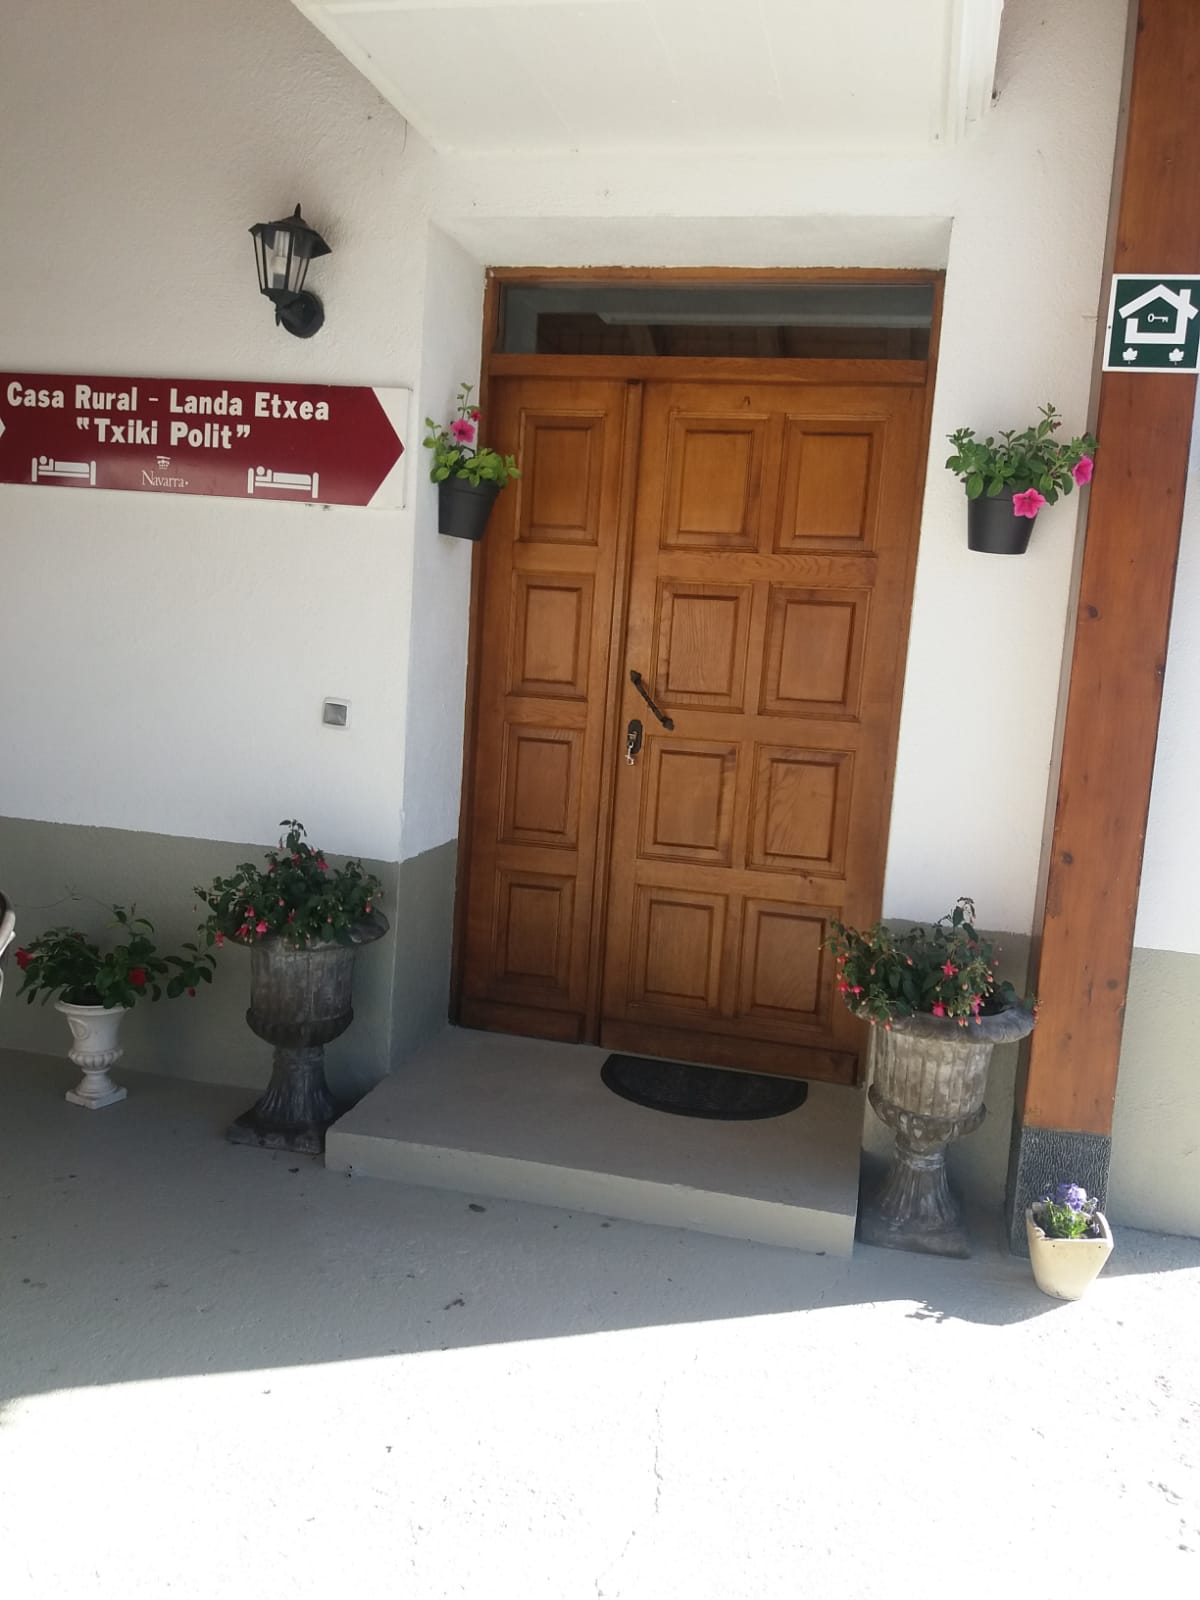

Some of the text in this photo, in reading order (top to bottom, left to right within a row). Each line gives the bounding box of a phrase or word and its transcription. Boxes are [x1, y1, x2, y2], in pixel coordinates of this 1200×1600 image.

[7, 381, 64, 409] Casa
[75, 384, 137, 412] Rural
[169, 388, 243, 417] Landa
[254, 393, 329, 421] Etxea
[76, 417, 251, 450] "Txiki Polit"
